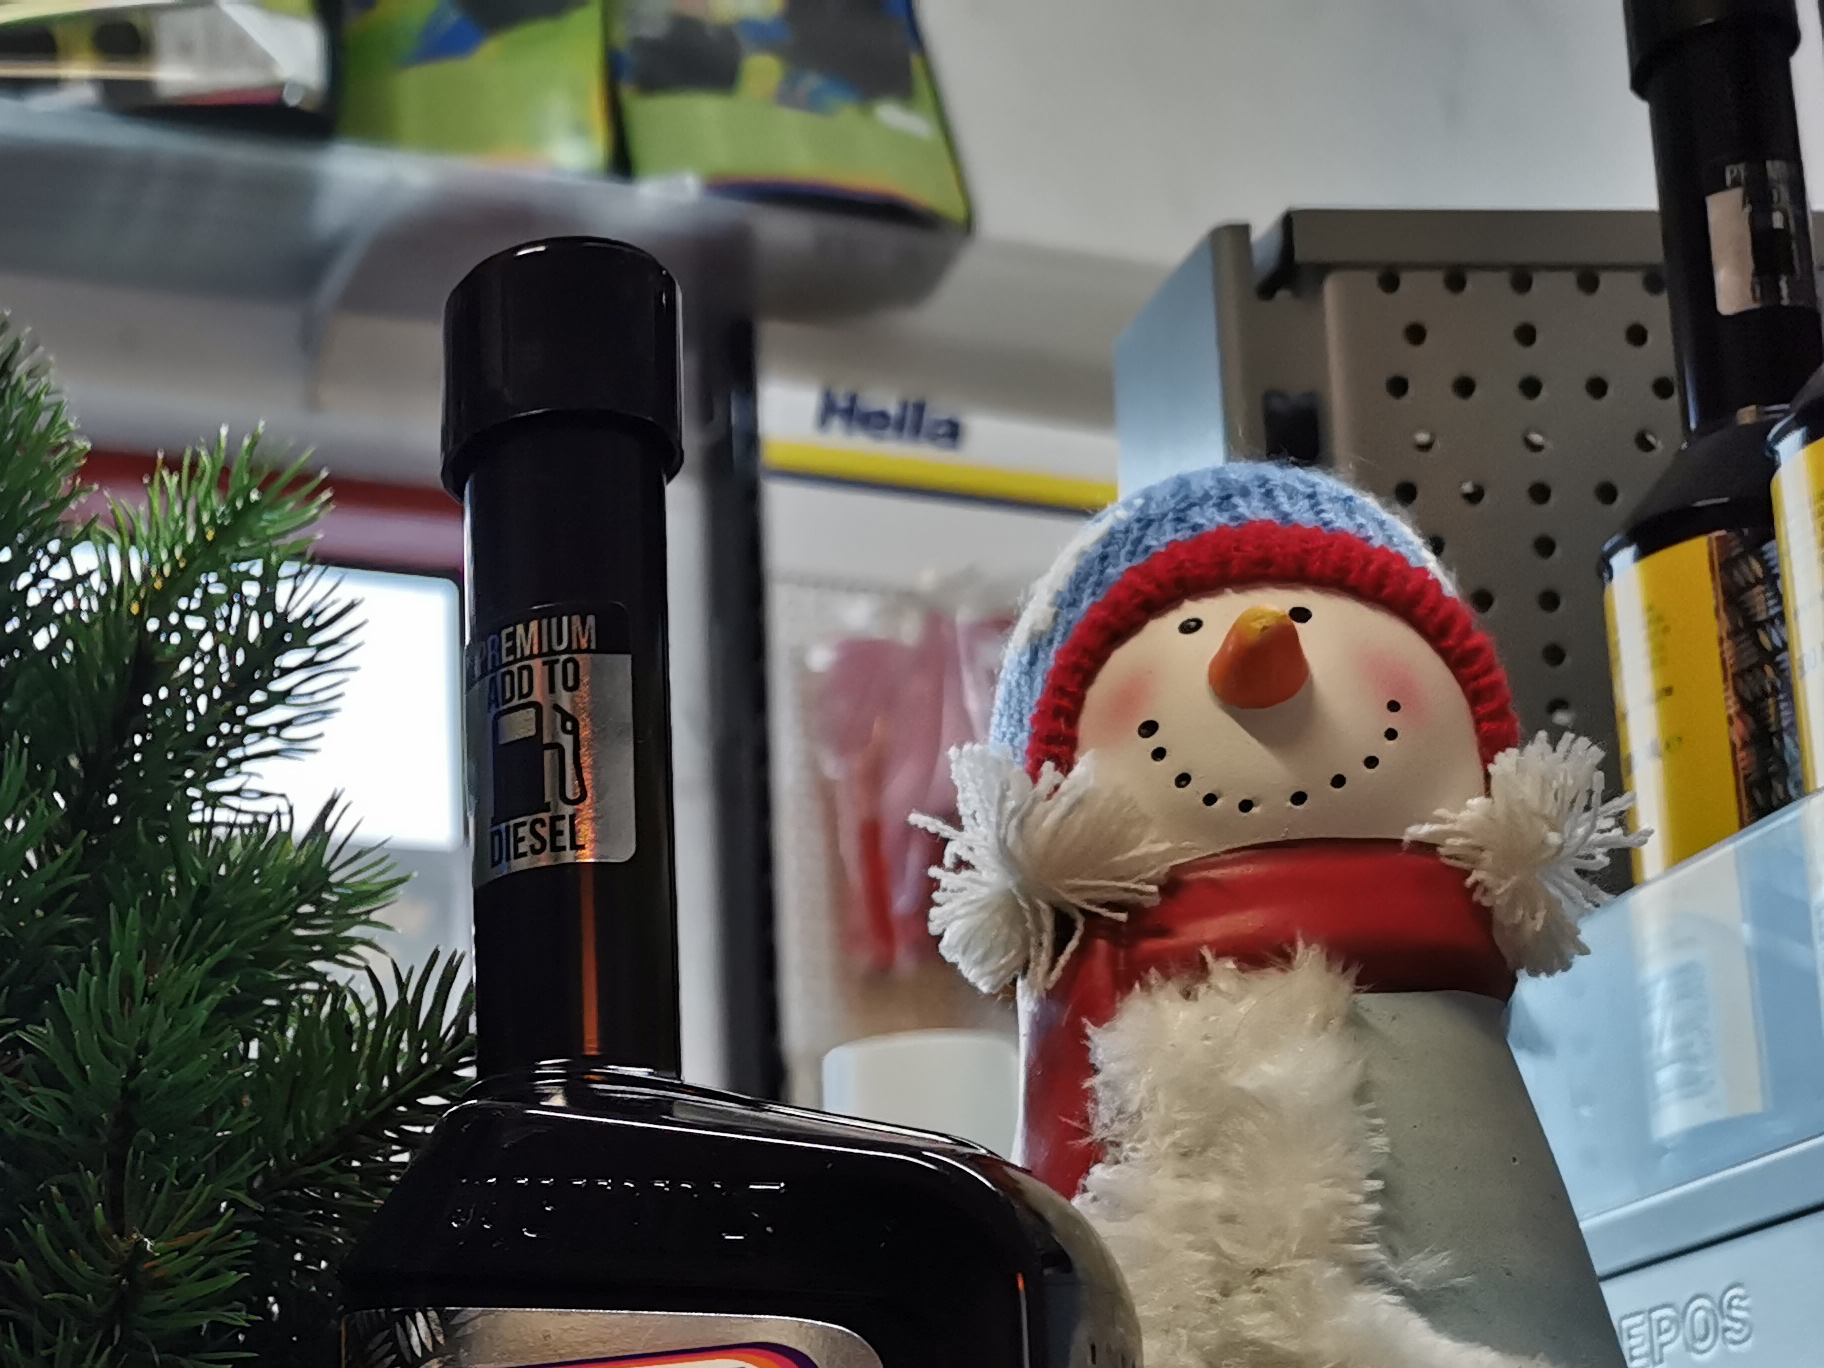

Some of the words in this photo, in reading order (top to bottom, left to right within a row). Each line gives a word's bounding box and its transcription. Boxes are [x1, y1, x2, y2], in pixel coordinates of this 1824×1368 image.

[817, 387, 962, 450] Hella
[477, 614, 597, 674] PREMIUM
[487, 664, 534, 710] ADD
[541, 656, 580, 694] TO
[490, 813, 586, 869] DIESEL
